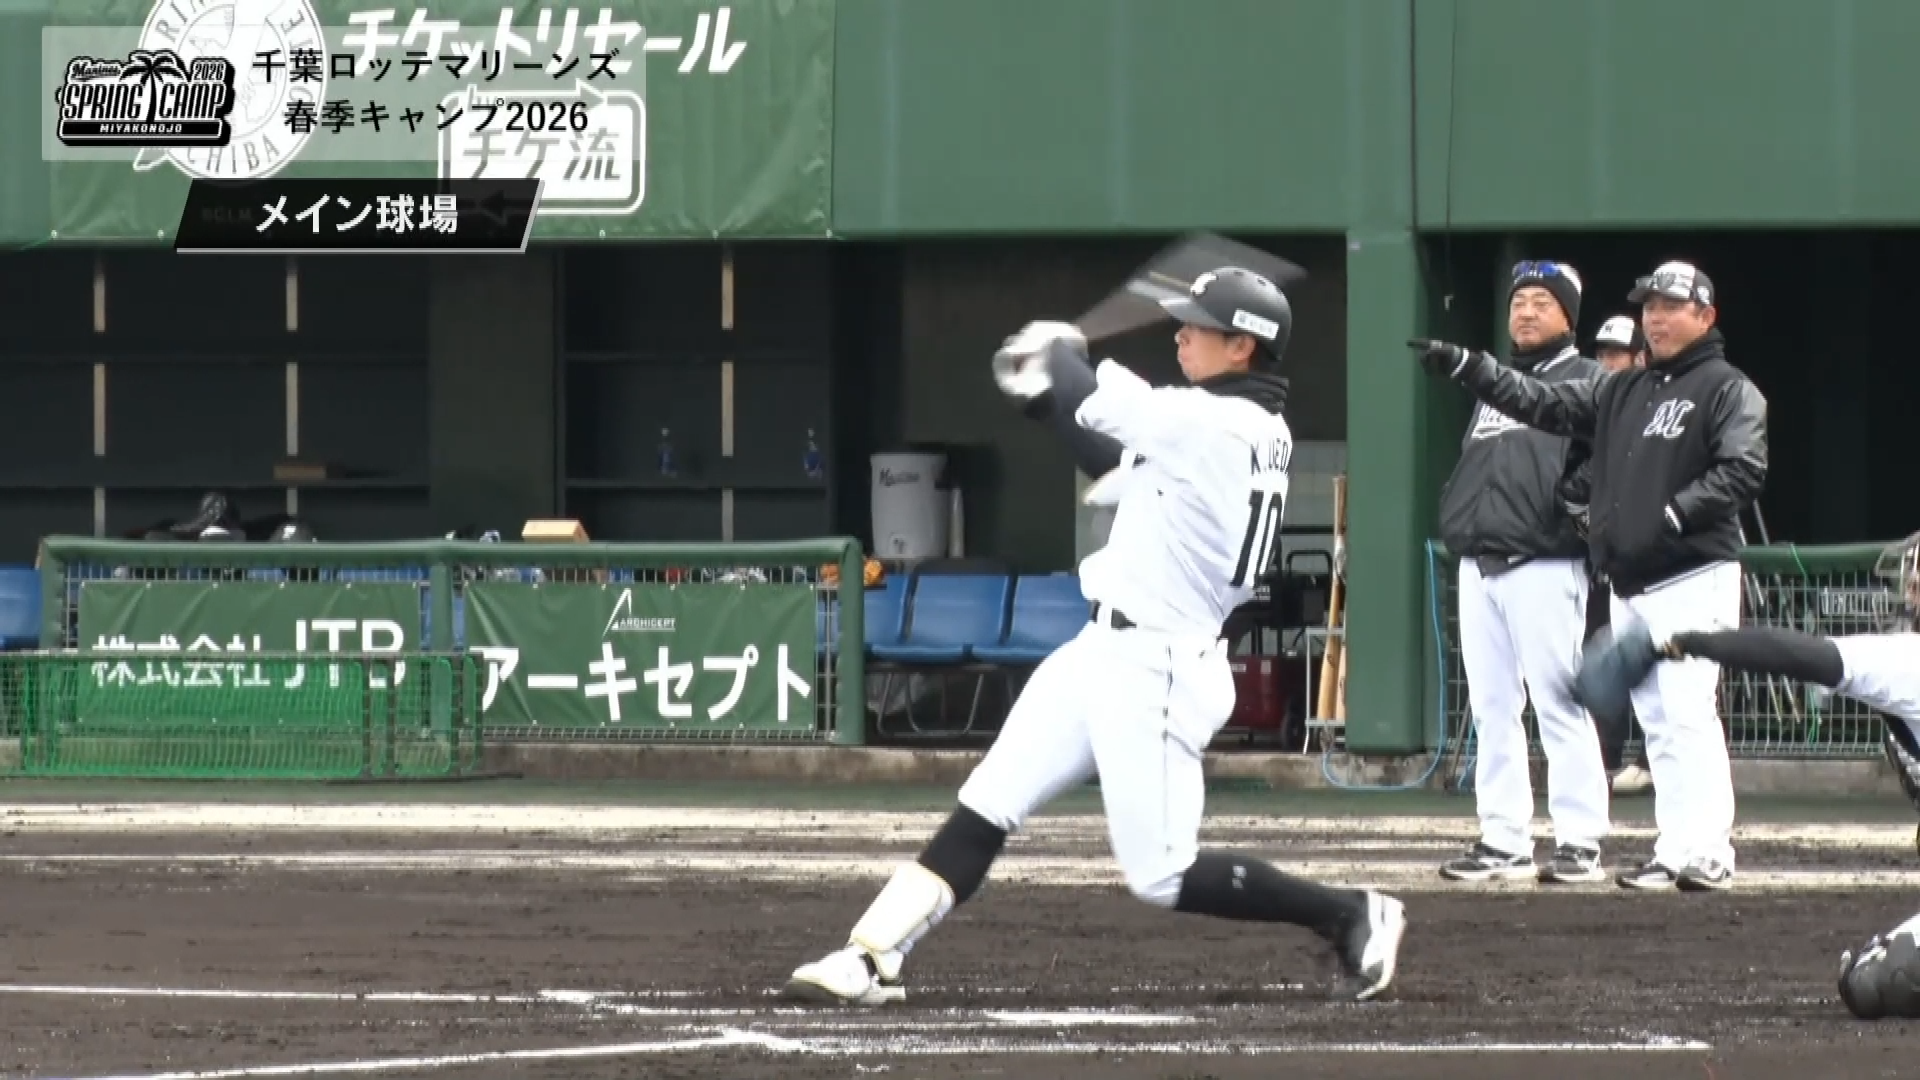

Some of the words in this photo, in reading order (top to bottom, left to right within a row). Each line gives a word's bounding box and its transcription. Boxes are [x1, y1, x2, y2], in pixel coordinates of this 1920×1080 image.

[342, 6, 748, 75] チケットリセール
[462, 127, 622, 181] チケ流
[91, 633, 271, 688] 株式会社
[284, 619, 406, 688] JTB
[469, 641, 812, 723] アーキセプト
